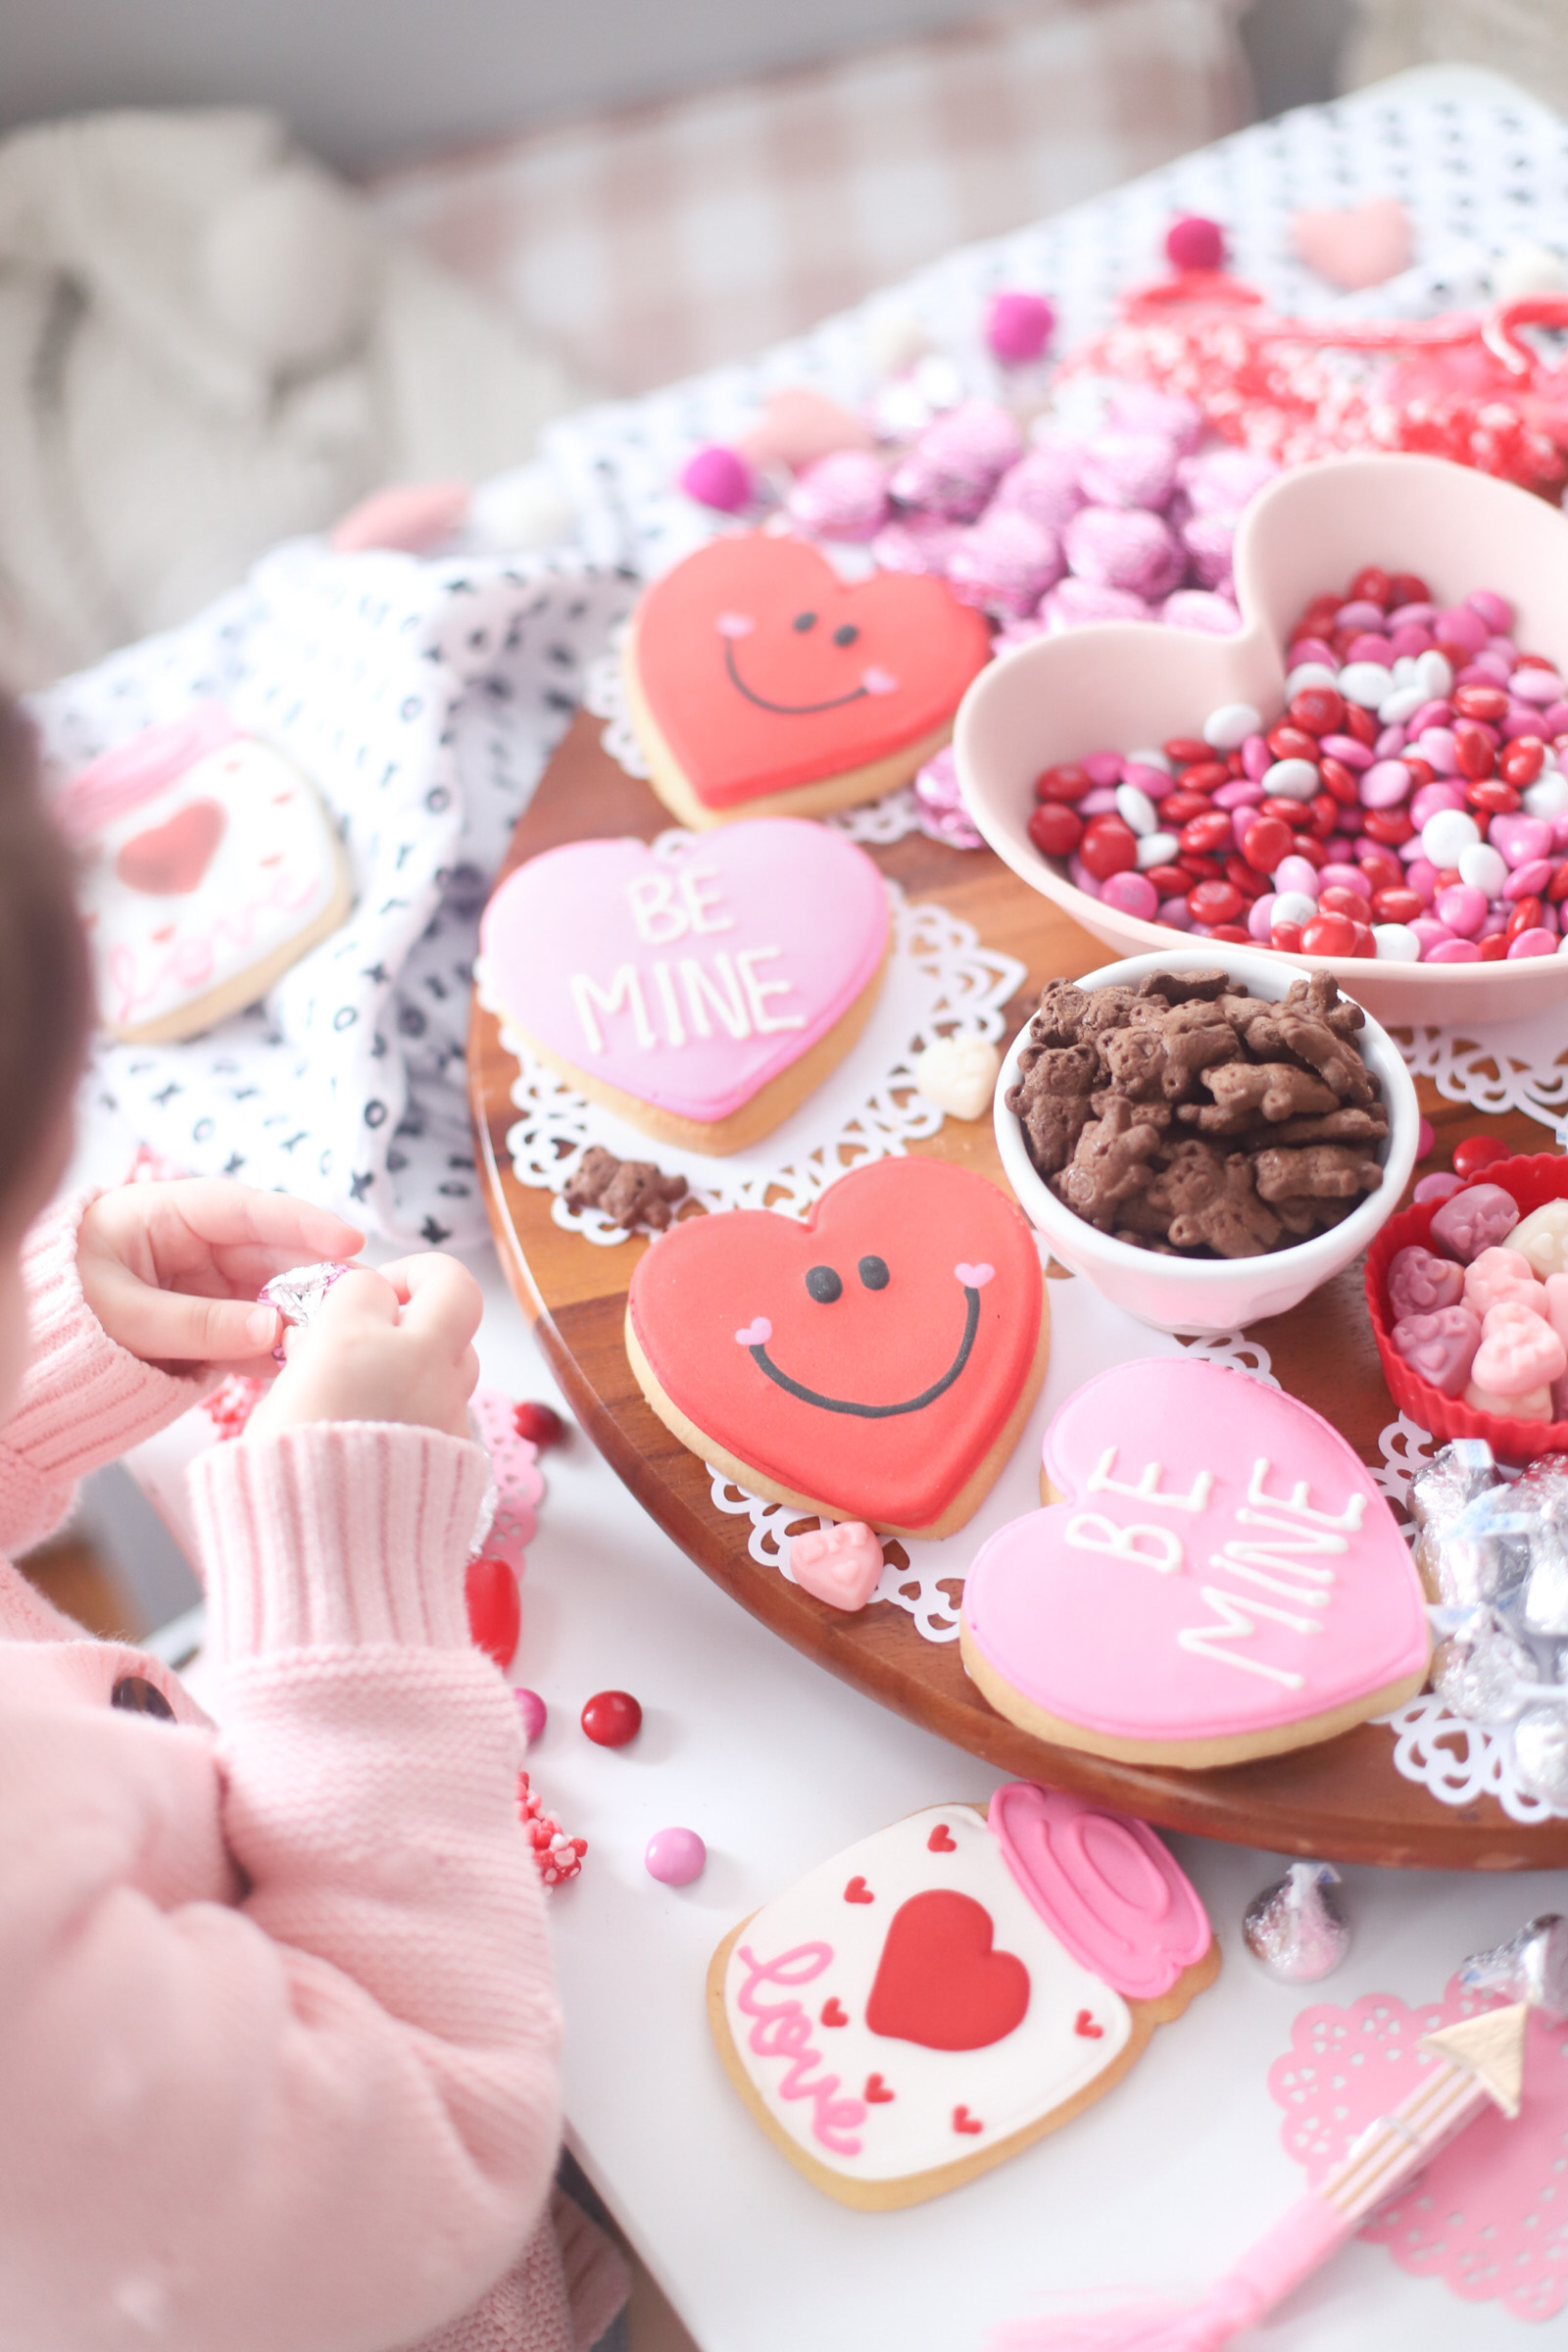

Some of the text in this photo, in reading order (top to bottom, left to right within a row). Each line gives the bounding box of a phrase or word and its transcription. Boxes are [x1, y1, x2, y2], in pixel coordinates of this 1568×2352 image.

[627, 862, 737, 945] BE
[568, 945, 806, 1054] MINE
[1064, 1445, 1215, 1576] BE
[1176, 1456, 1369, 1690] MINE
